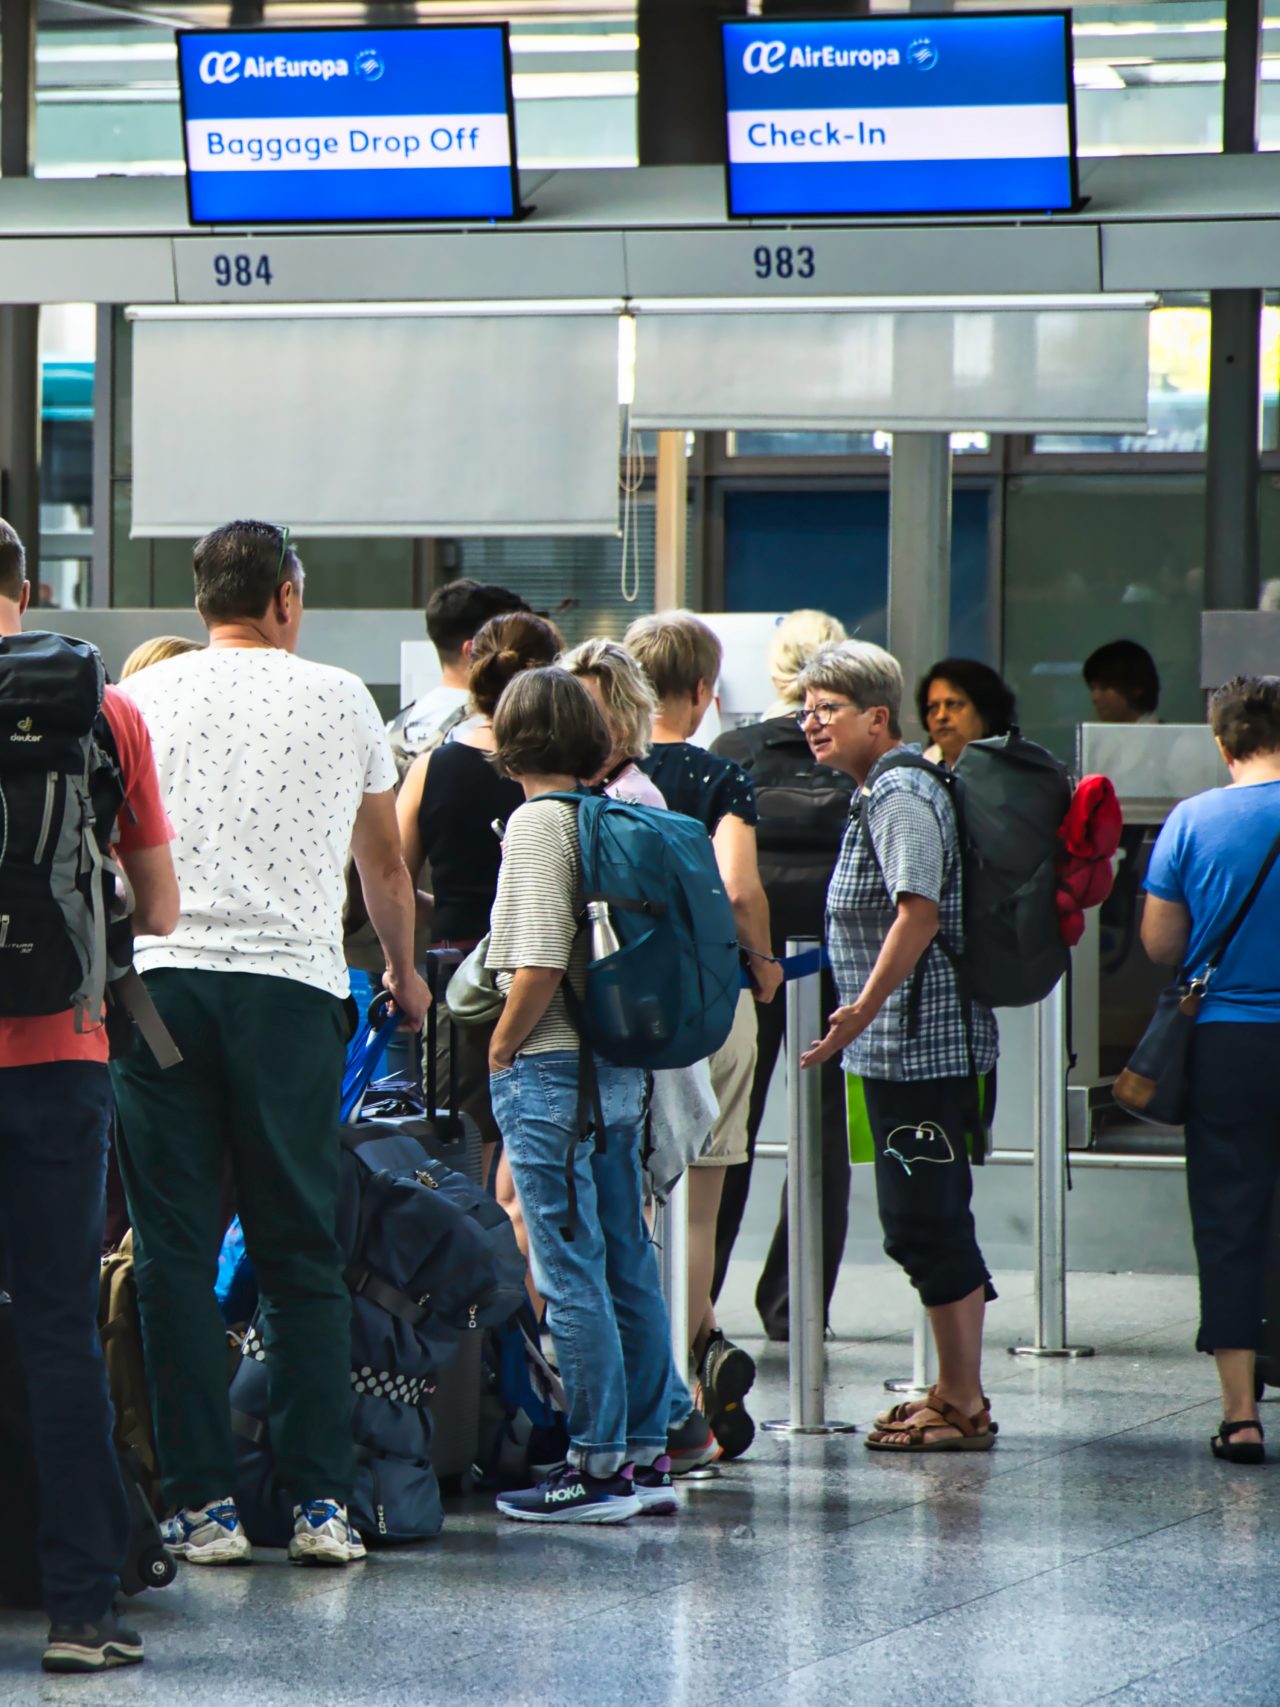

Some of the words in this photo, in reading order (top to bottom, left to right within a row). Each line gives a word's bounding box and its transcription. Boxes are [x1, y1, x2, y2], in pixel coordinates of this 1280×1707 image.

[243, 56, 349, 81] AirEuropa
[789, 45, 901, 71] AirEuropa
[207, 131, 339, 161] Baggage
[349, 129, 420, 159] Drop
[429, 126, 480, 152] Off
[747, 121, 887, 148] Check-In
[213, 253, 274, 288] 984
[753, 245, 816, 280] 983
[9, 732, 43, 742] deuter
[544, 1483, 587, 1504] HOKA
